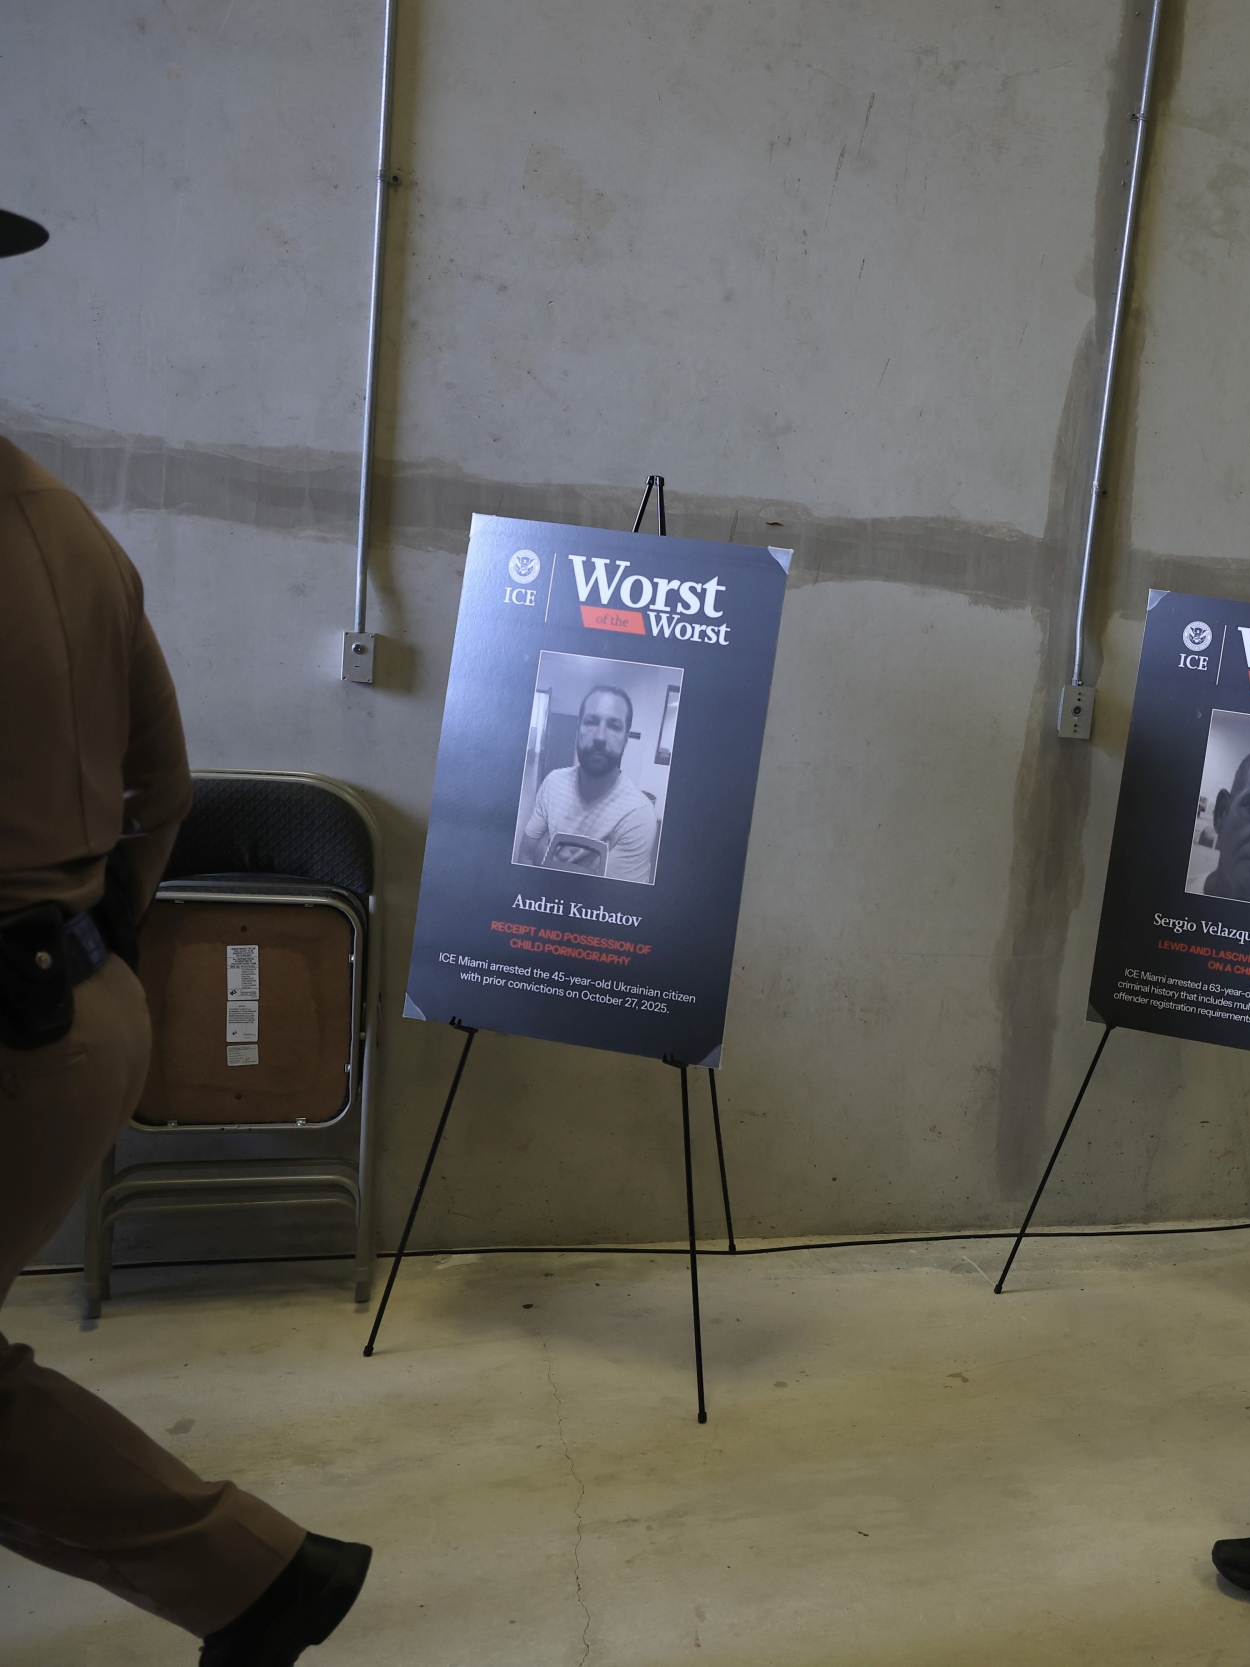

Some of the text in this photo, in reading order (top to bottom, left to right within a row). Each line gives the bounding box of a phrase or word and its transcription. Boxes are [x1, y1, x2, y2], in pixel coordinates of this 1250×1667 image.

[502, 586, 537, 607] ICE
[567, 554, 727, 619] Worst
[595, 612, 630, 629] of the
[647, 611, 731, 647] Worst
[1178, 652, 1209, 671] ICE
[511, 893, 643, 928] Andrii Kurbatov
[1153, 912, 1197, 934] Sergio
[491, 920, 653, 956] RECEIPT AND POSSESSION OF
[1158, 939, 1188, 953] LEWD
[1189, 945, 1211, 957] AND
[510, 938, 631, 967] CHILD PORNOGRAPHY
[438, 952, 697, 1004] ICE Miami arrested the 45-year-old Ukrainian citizen
[1124, 968, 1140, 979] ICE
[1140, 971, 1167, 983] Miami
[1166, 977, 1202, 990] arrested
[1207, 960, 1224, 972] ON
[1224, 963, 1233, 973] A
[460, 971, 670, 1014] with prior convictions on October 27, 2025.
[1113, 991, 1150, 1005] offender
[1149, 998, 1197, 1014] registration
[1117, 980, 1150, 993] criminal
[1151, 985, 1179, 1000] history
[1180, 991, 1197, 1002] that
[1198, 993, 1233, 1008] includes
